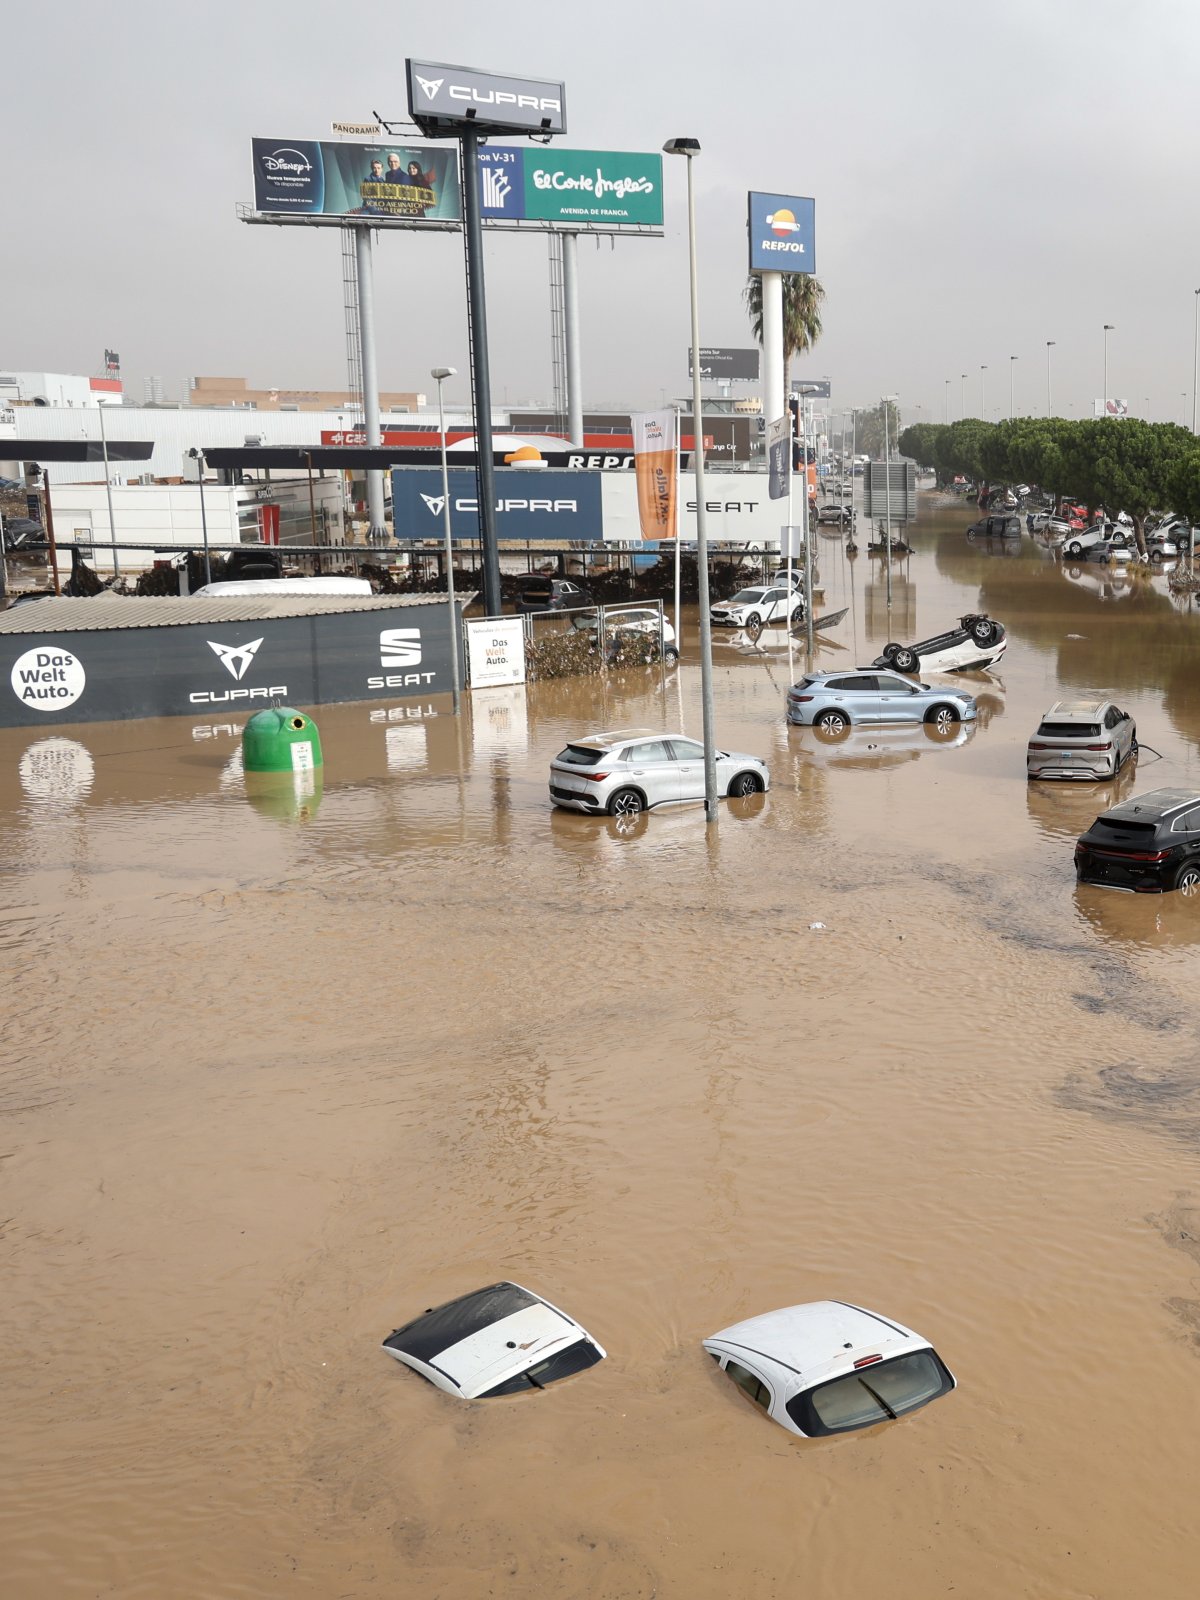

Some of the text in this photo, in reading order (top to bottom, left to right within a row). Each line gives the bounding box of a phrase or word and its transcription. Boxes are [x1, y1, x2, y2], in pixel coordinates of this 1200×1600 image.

[449, 85, 561, 112] CUPRA
[332, 123, 380, 134] PANORAMIX
[492, 152, 516, 163] V-31
[533, 168, 654, 198] El Corte Inglés
[560, 207, 589, 215] AVENIDA
[761, 240, 805, 253] REPSOL
[568, 455, 634, 469] REPS
[686, 501, 759, 513] SEAT
[492, 639, 508, 647] Das
[486, 647, 505, 657] Welt
[36, 653, 74, 668] Das
[486, 656, 509, 665] Auto.
[19, 668, 67, 684] Welt
[367, 671, 437, 690] SEAT
[22, 685, 75, 700] Auto.
[189, 685, 288, 703] CUPRA
